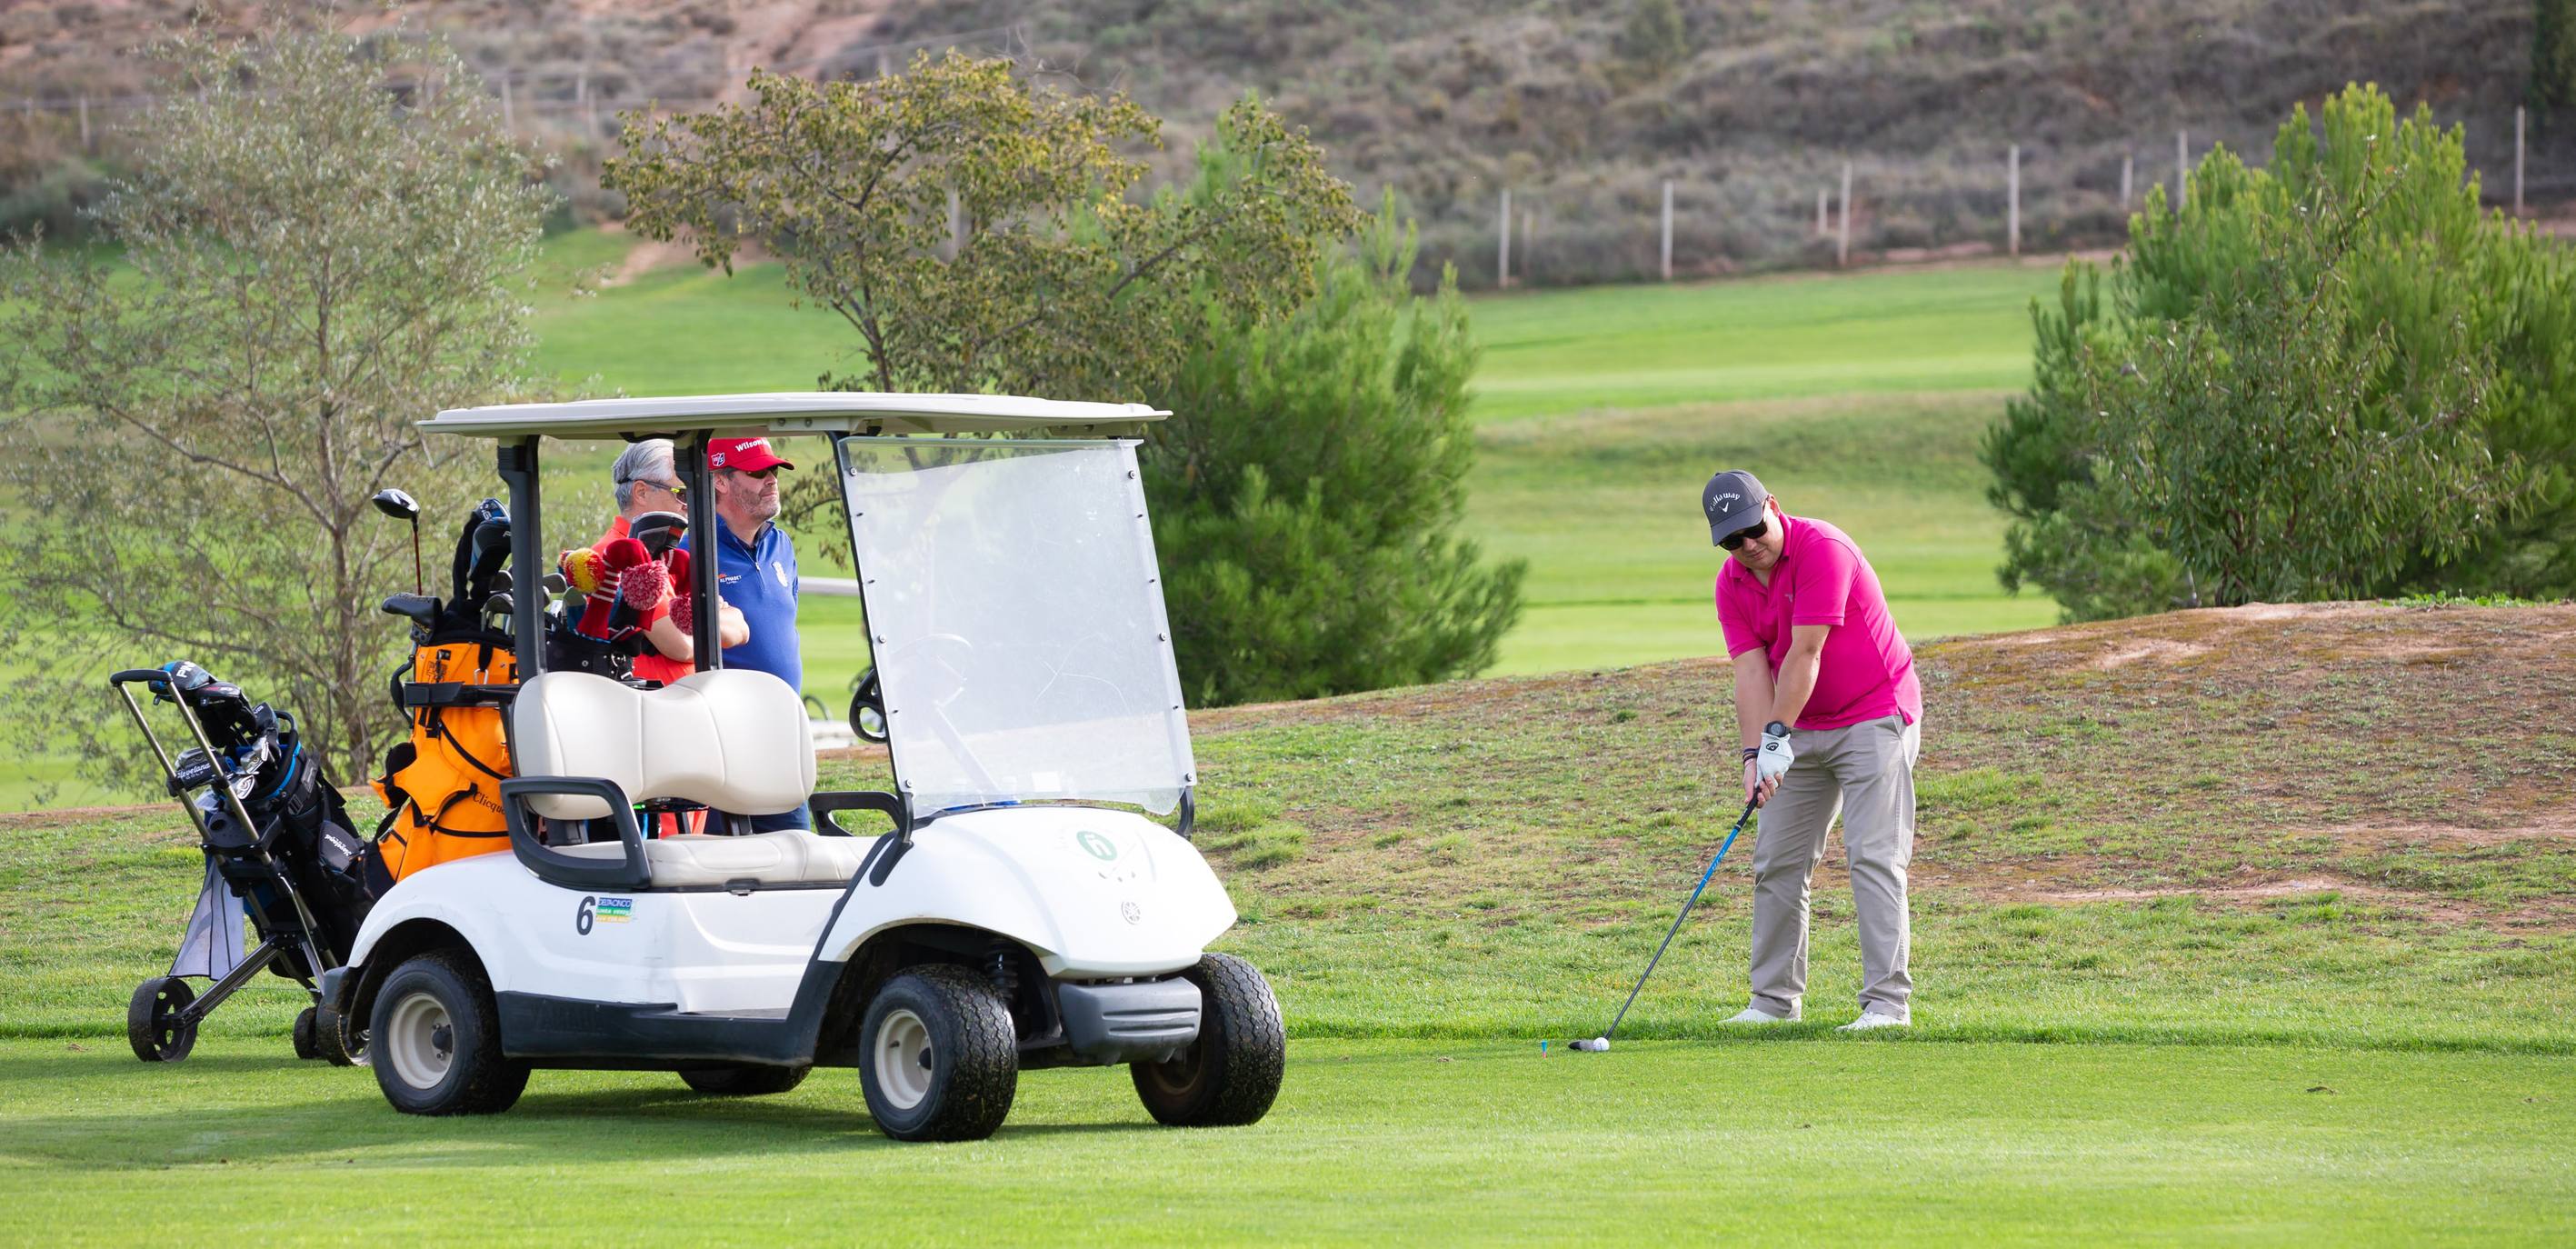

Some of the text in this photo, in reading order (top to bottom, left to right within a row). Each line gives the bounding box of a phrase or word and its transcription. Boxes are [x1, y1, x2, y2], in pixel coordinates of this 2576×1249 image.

[735, 439, 763, 452] Wilson
[176, 661, 196, 678] PIN
[576, 895, 595, 936] 6
